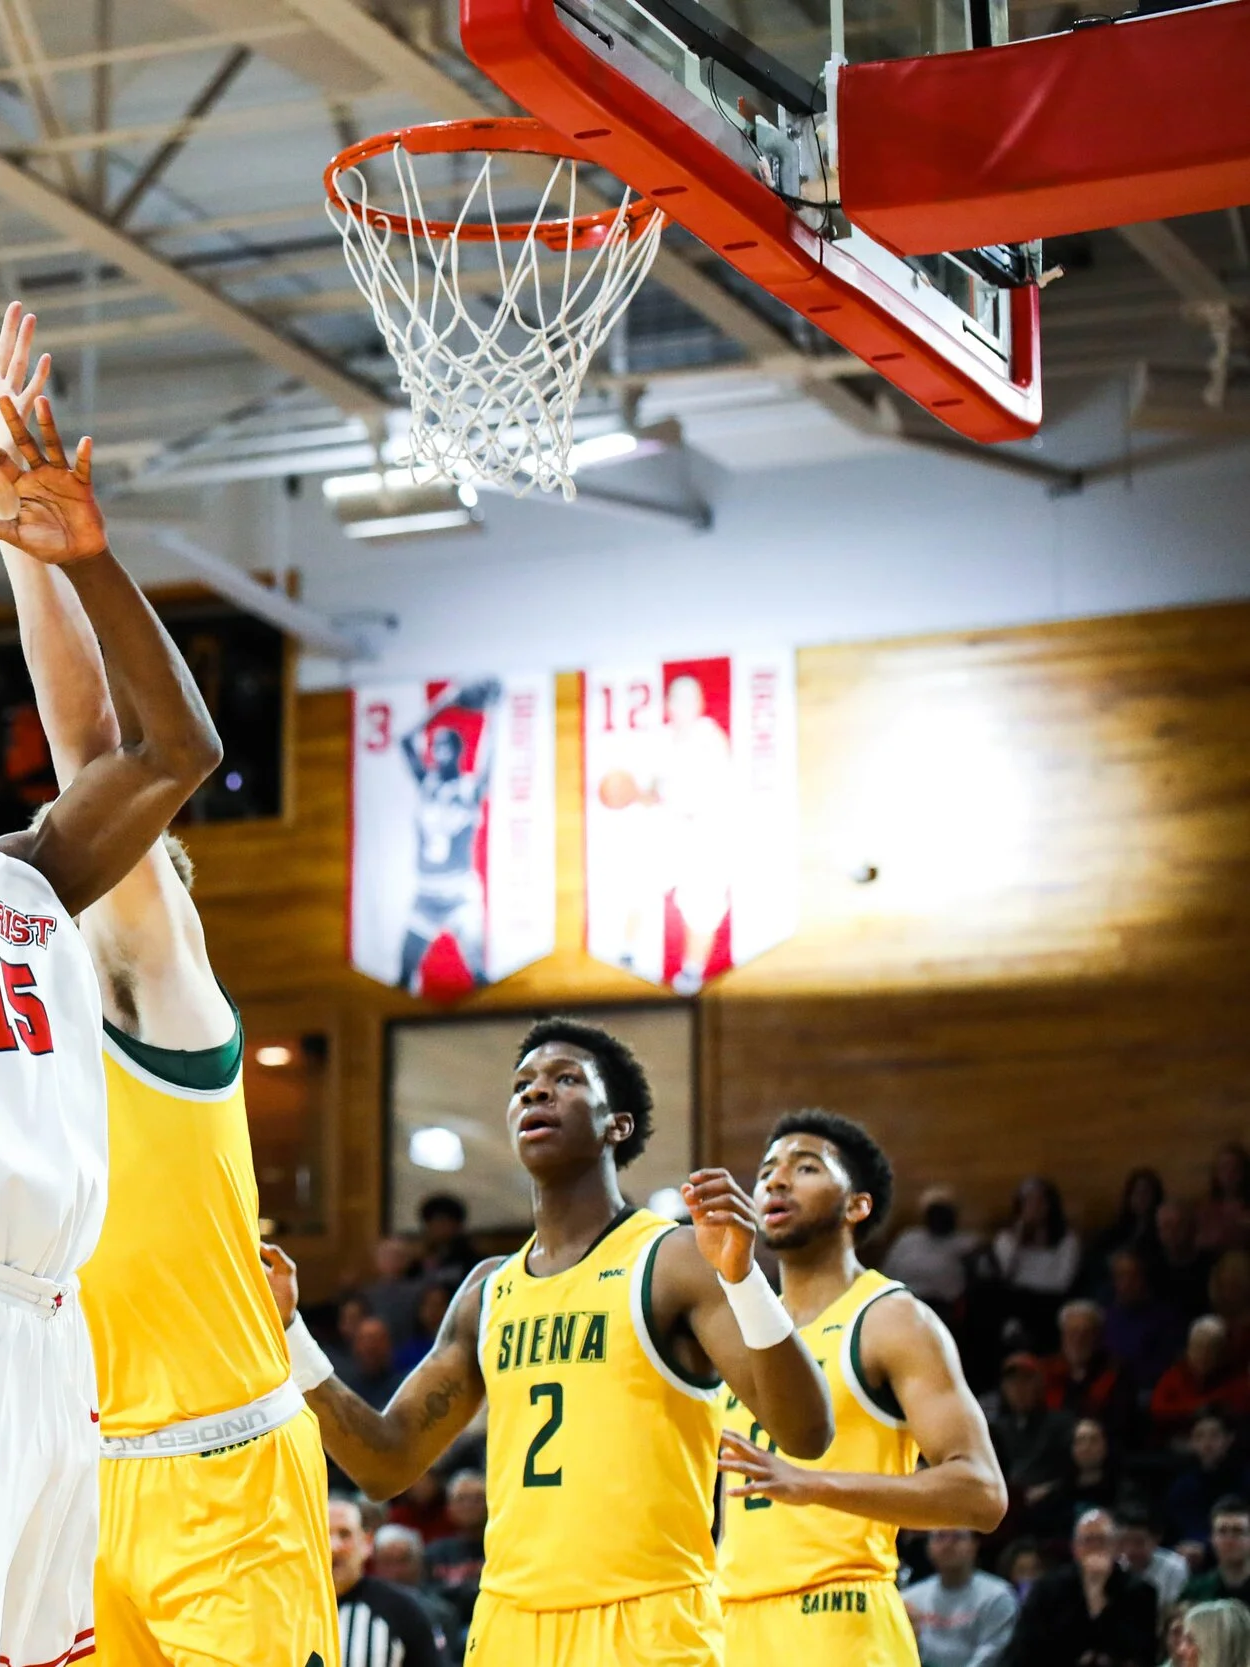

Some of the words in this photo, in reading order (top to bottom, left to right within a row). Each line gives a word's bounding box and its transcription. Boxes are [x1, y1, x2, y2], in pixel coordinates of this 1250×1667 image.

[365, 703, 392, 752] 3
[600, 684, 651, 732] 12
[497, 1311, 609, 1374] SIENA
[155, 1408, 268, 1449] UNDER
[522, 1382, 563, 1488] 2
[801, 1591, 867, 1614] SAINTS
